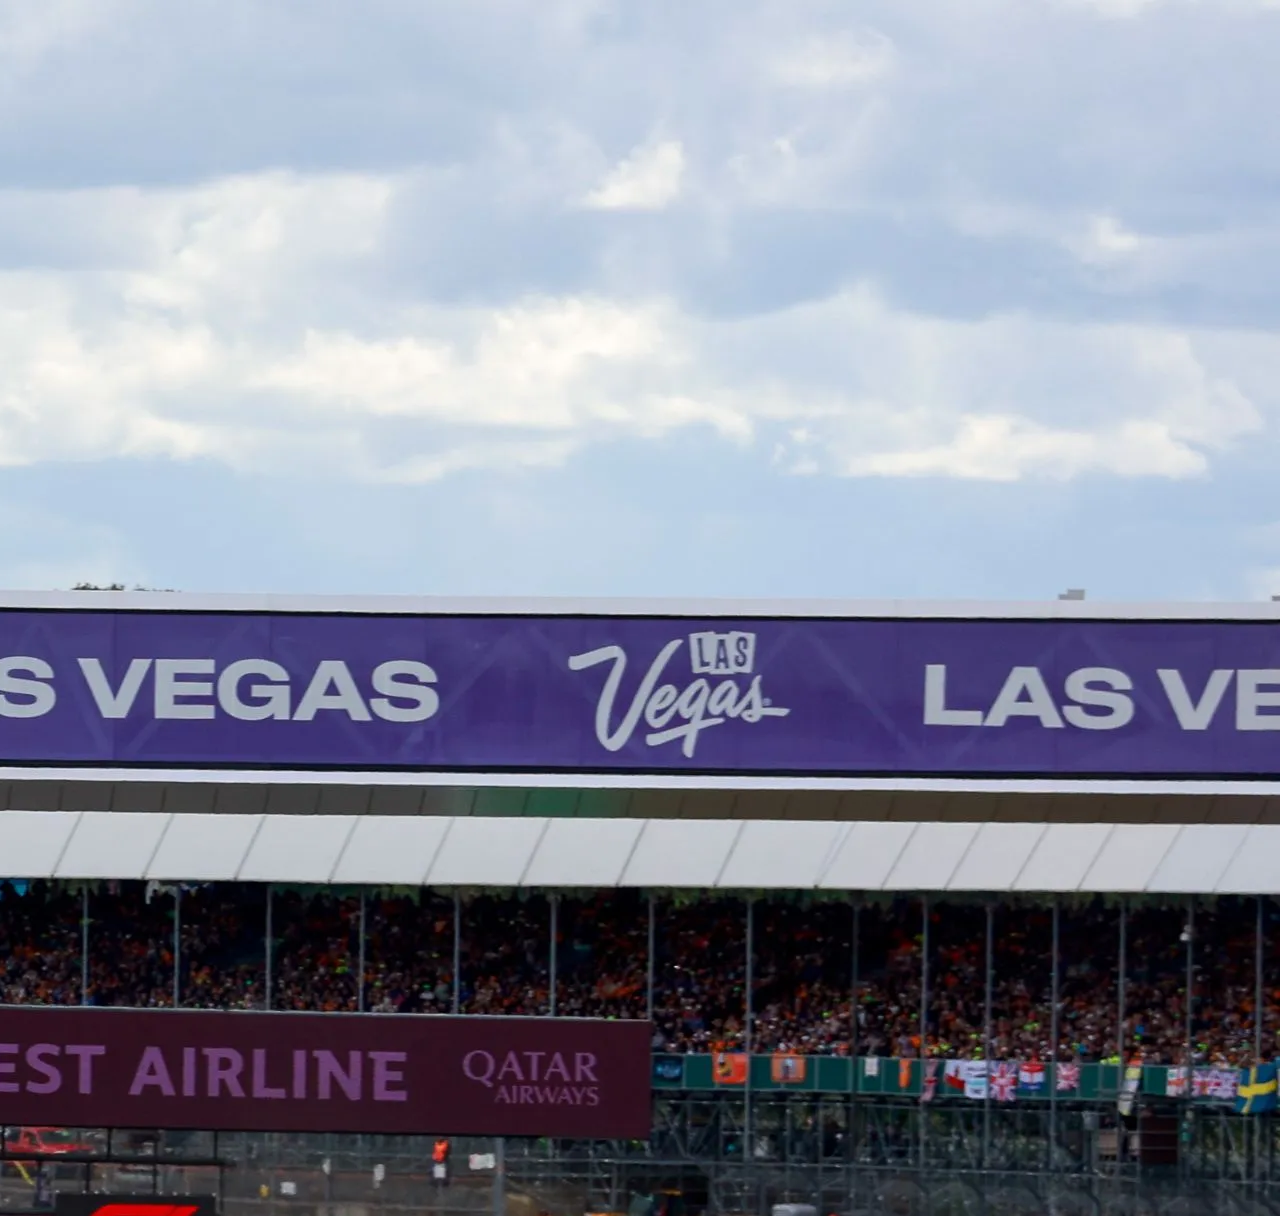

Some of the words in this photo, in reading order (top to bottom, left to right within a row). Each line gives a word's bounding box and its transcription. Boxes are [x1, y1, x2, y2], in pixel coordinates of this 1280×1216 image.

[690, 631, 755, 674] LAS
[90, 656, 440, 724] VEGAS
[923, 663, 1134, 729] LAS
[128, 1045, 409, 1103] AIRLINE
[462, 1048, 600, 1087] QATAR
[495, 1084, 601, 1107] AIRWAYS
